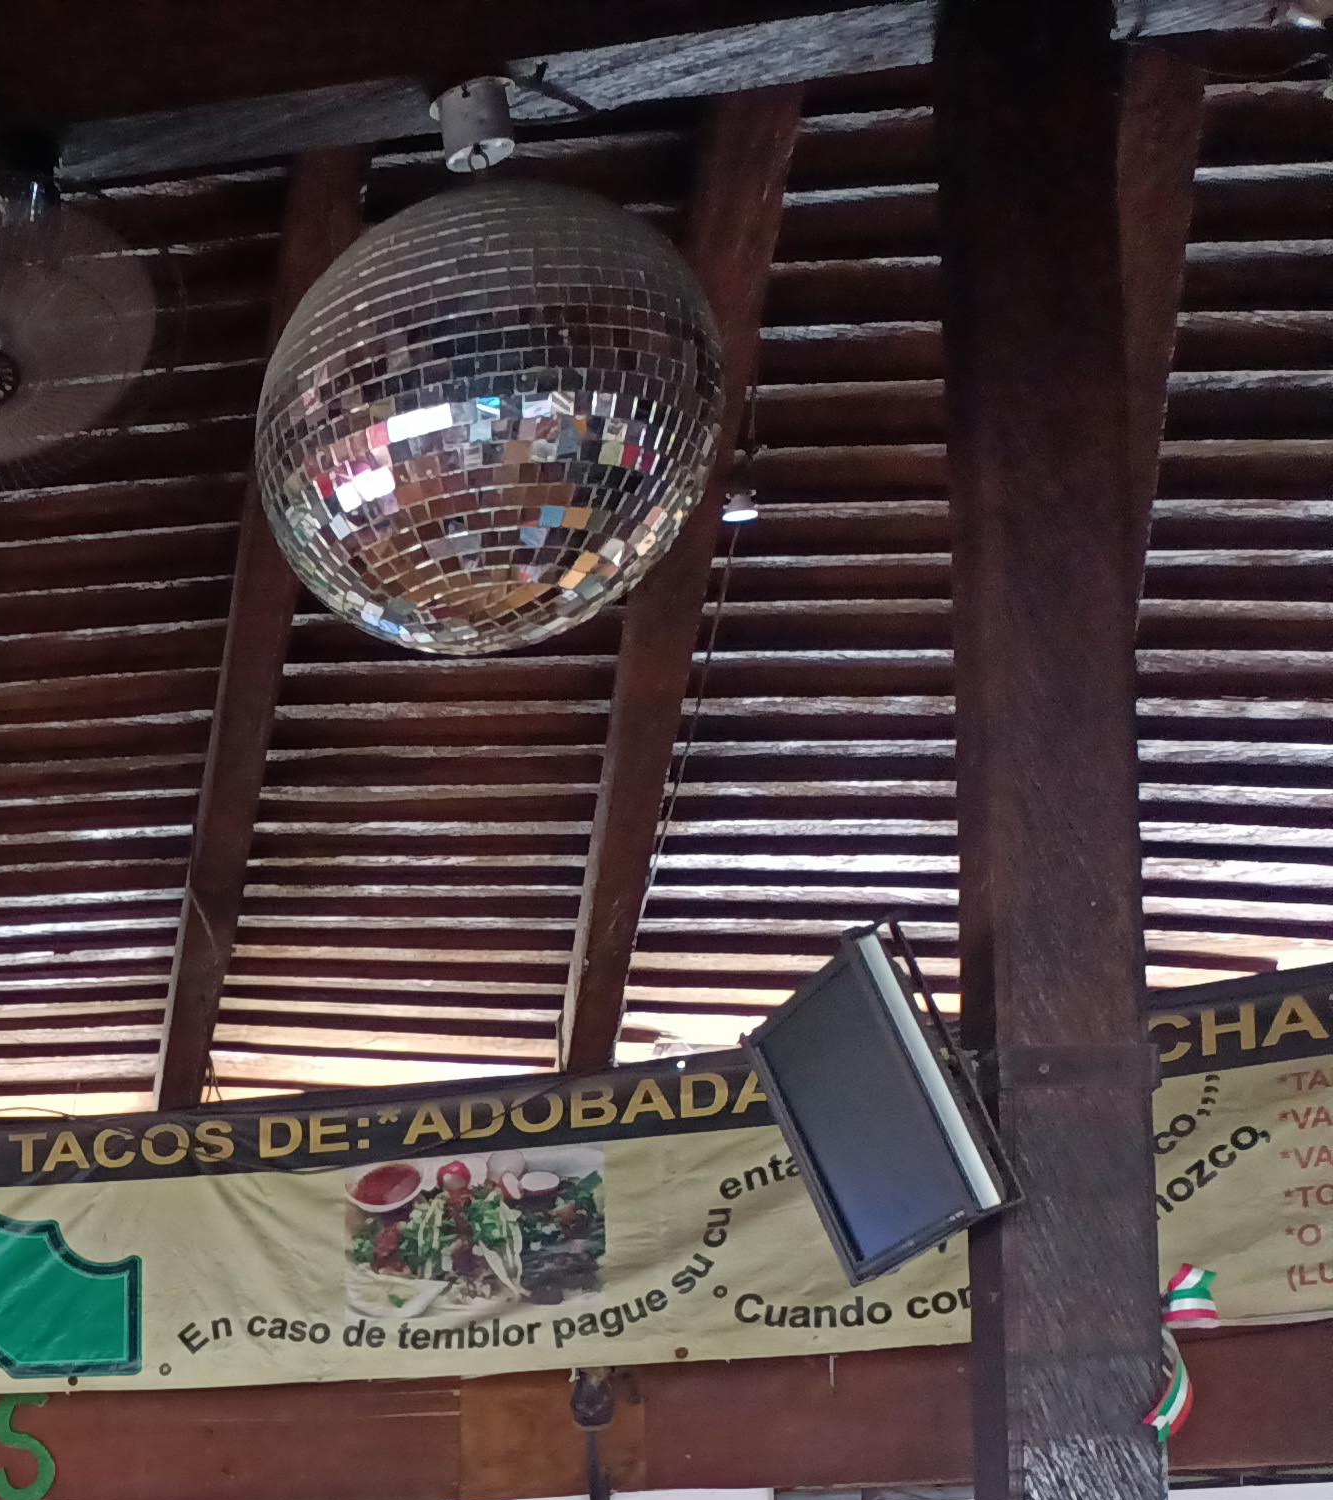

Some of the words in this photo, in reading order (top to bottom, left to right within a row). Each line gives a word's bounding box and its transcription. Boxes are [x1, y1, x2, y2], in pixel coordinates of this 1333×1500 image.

[9, 1121, 235, 1173] TACOS
[178, 1313, 233, 1354] En
[246, 1315, 331, 1344] caso
[343, 1320, 386, 1347] de
[398, 1319, 542, 1350] temblor
[553, 1287, 669, 1348] pague
[670, 1254, 716, 1296] su
[734, 1293, 892, 1328] Cuando
